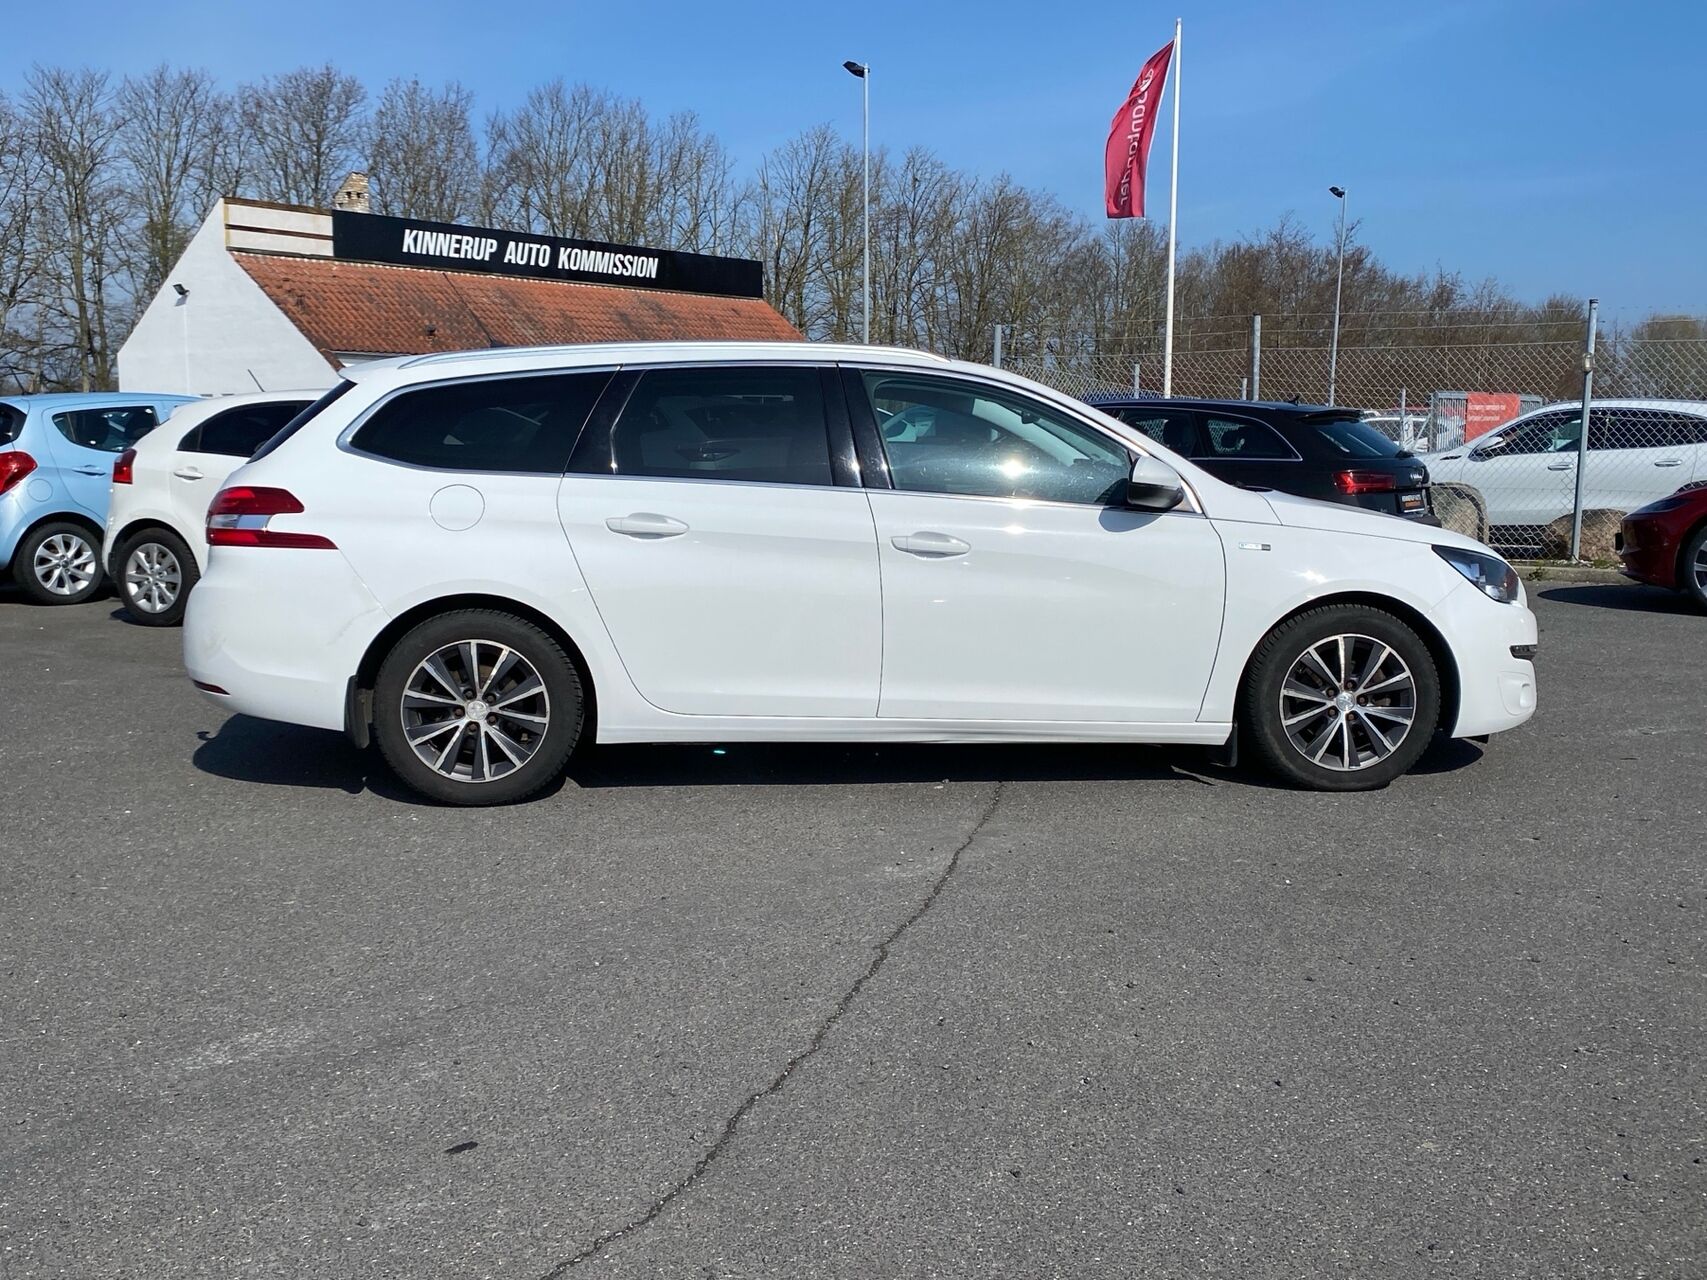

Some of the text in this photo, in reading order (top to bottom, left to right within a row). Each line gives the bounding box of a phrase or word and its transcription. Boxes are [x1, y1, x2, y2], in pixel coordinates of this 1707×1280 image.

[402, 228, 659, 279] KINNERUP AUTO KOMMISSION
